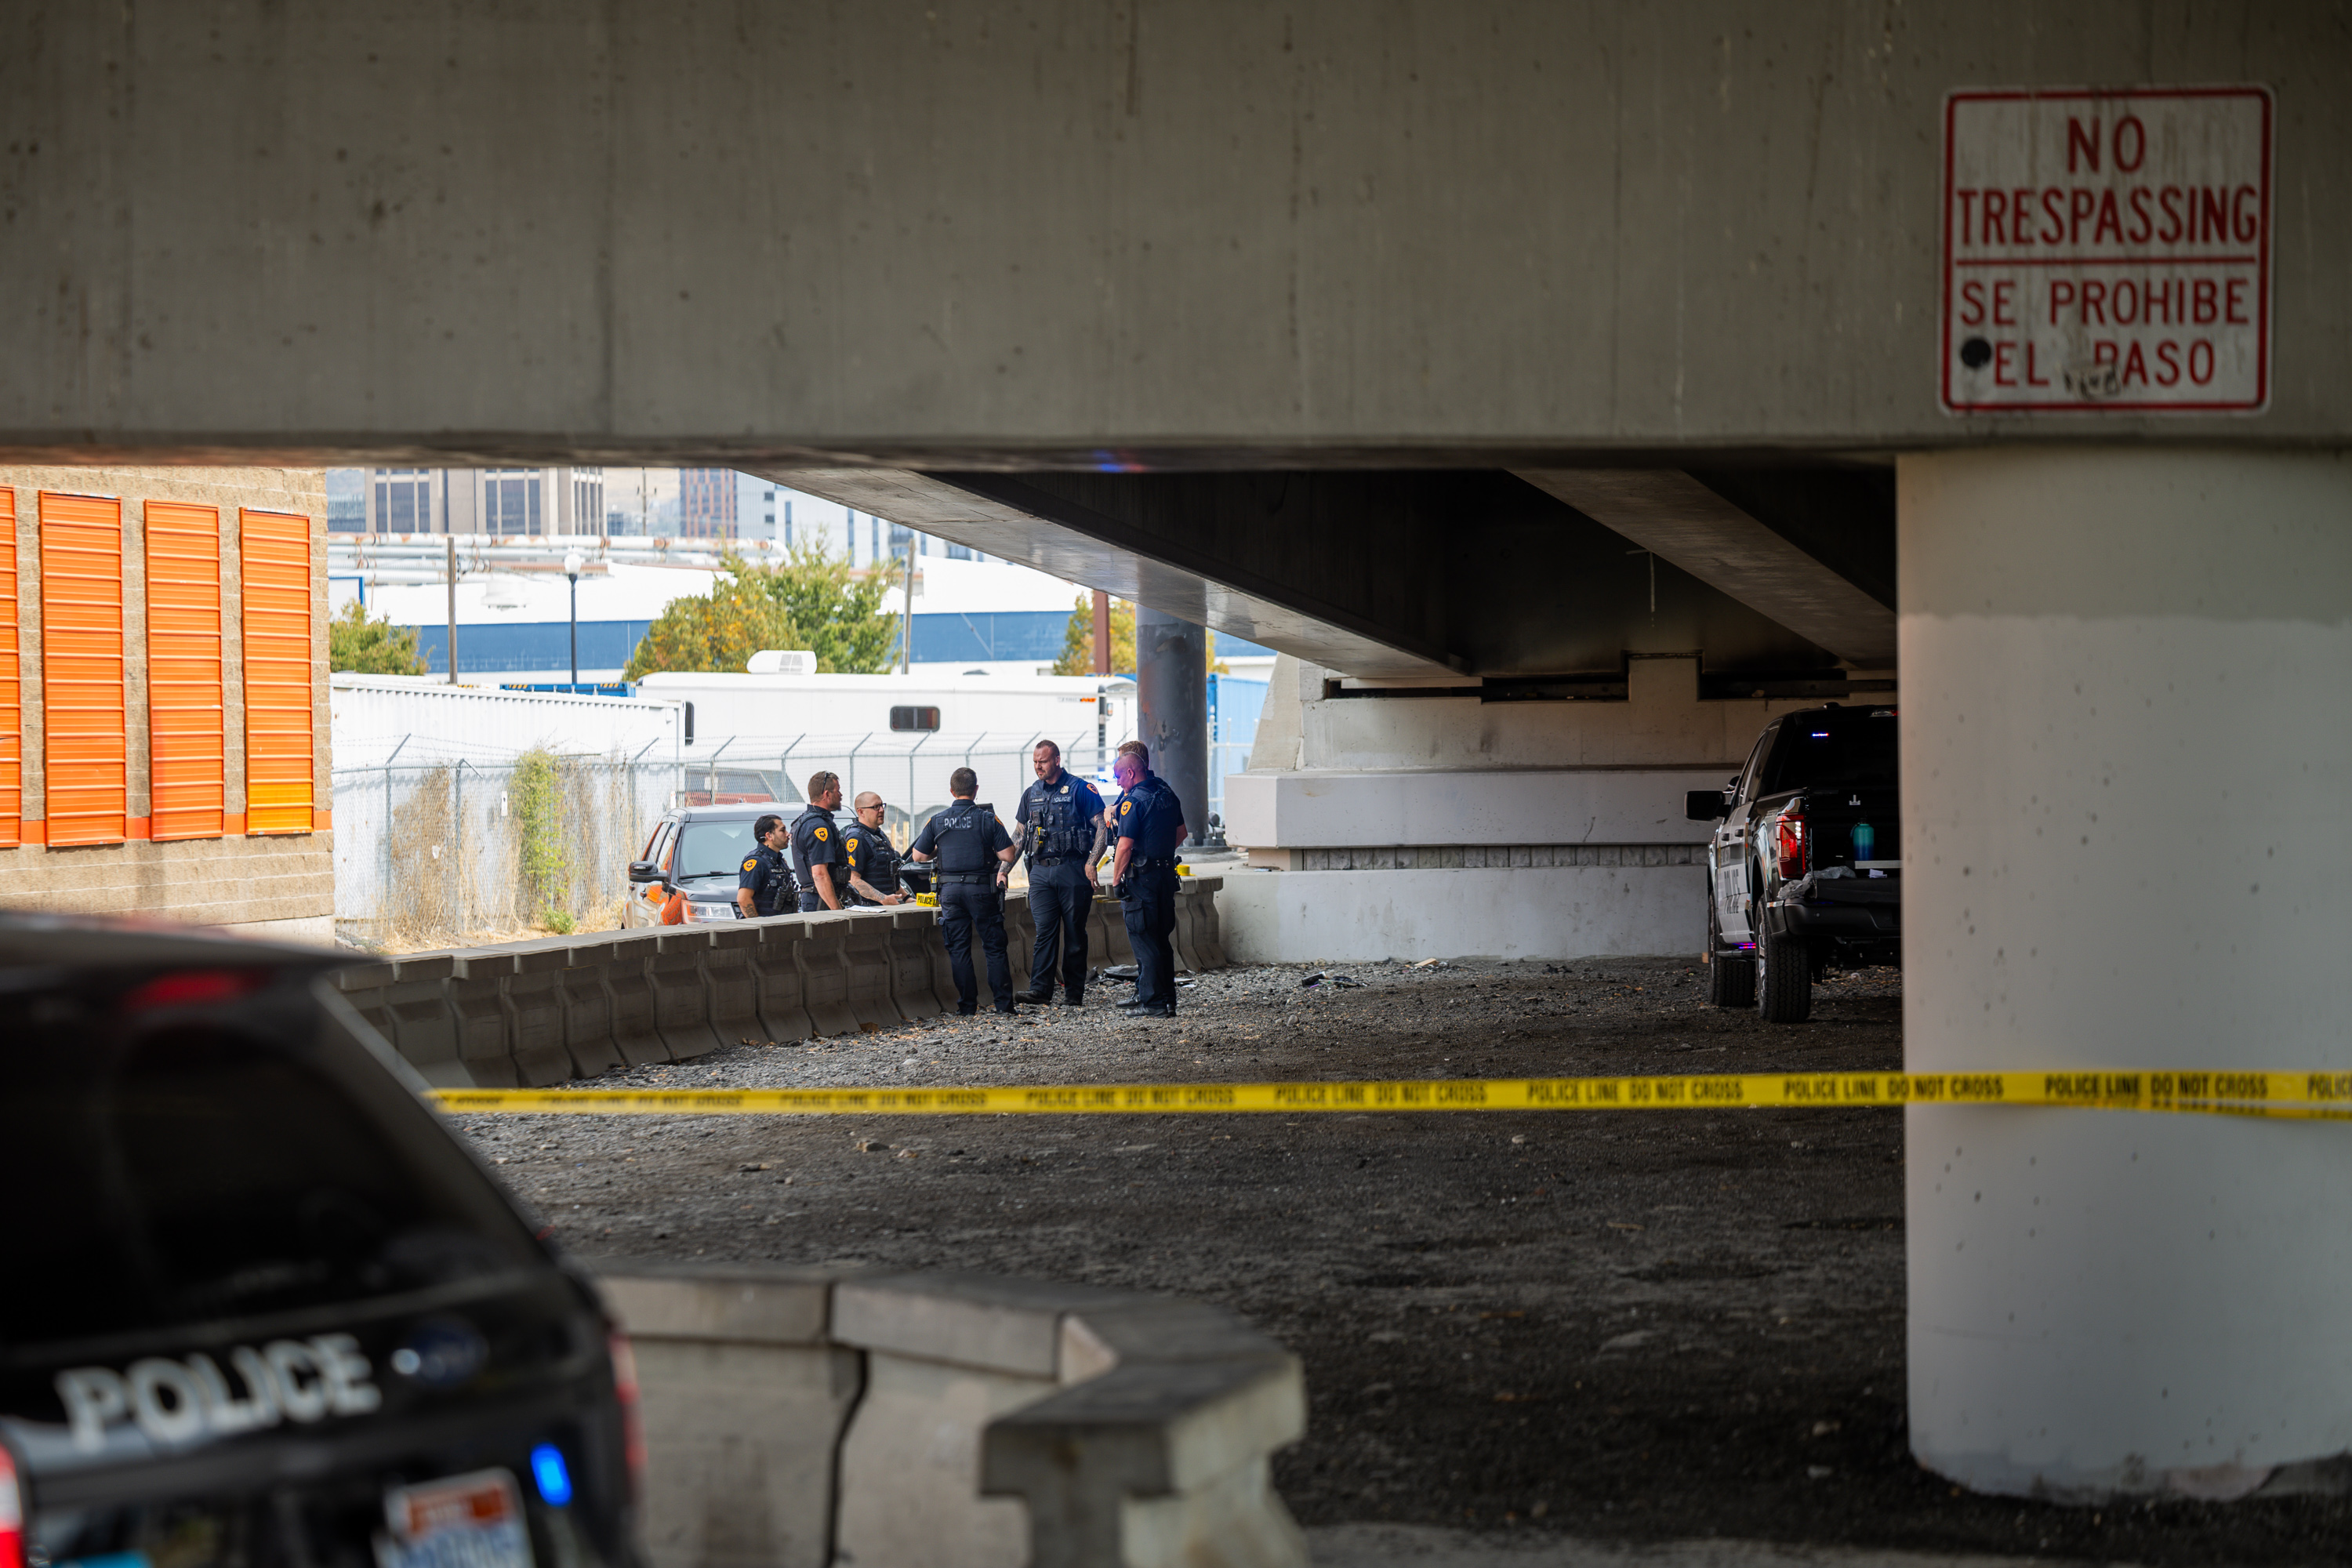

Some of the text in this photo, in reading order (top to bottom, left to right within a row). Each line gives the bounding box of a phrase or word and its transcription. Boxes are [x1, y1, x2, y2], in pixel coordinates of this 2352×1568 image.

[2067, 115, 2147, 174] NO
[1957, 184, 2258, 246] TRESPASSING
[1961, 278, 2250, 326] SE PROHIBE
[1994, 339, 2049, 387] EL
[2094, 338, 2216, 387] PASO
[944, 816, 971, 829] POLICE
[917, 895, 933, 906] POLICE
[1436, 1084, 1487, 1103] CROSS
[1527, 1080, 1744, 1102] POLICE LINE DO NOT CROSS
[1784, 1076, 2004, 1099] POLICE LINE DO NOT CROSS
[2045, 1074, 2268, 1098] POLICE LINE DO NOT CROSS
[2307, 1073, 2352, 1100] POLIC
[55, 1333, 381, 1454] POLICE
